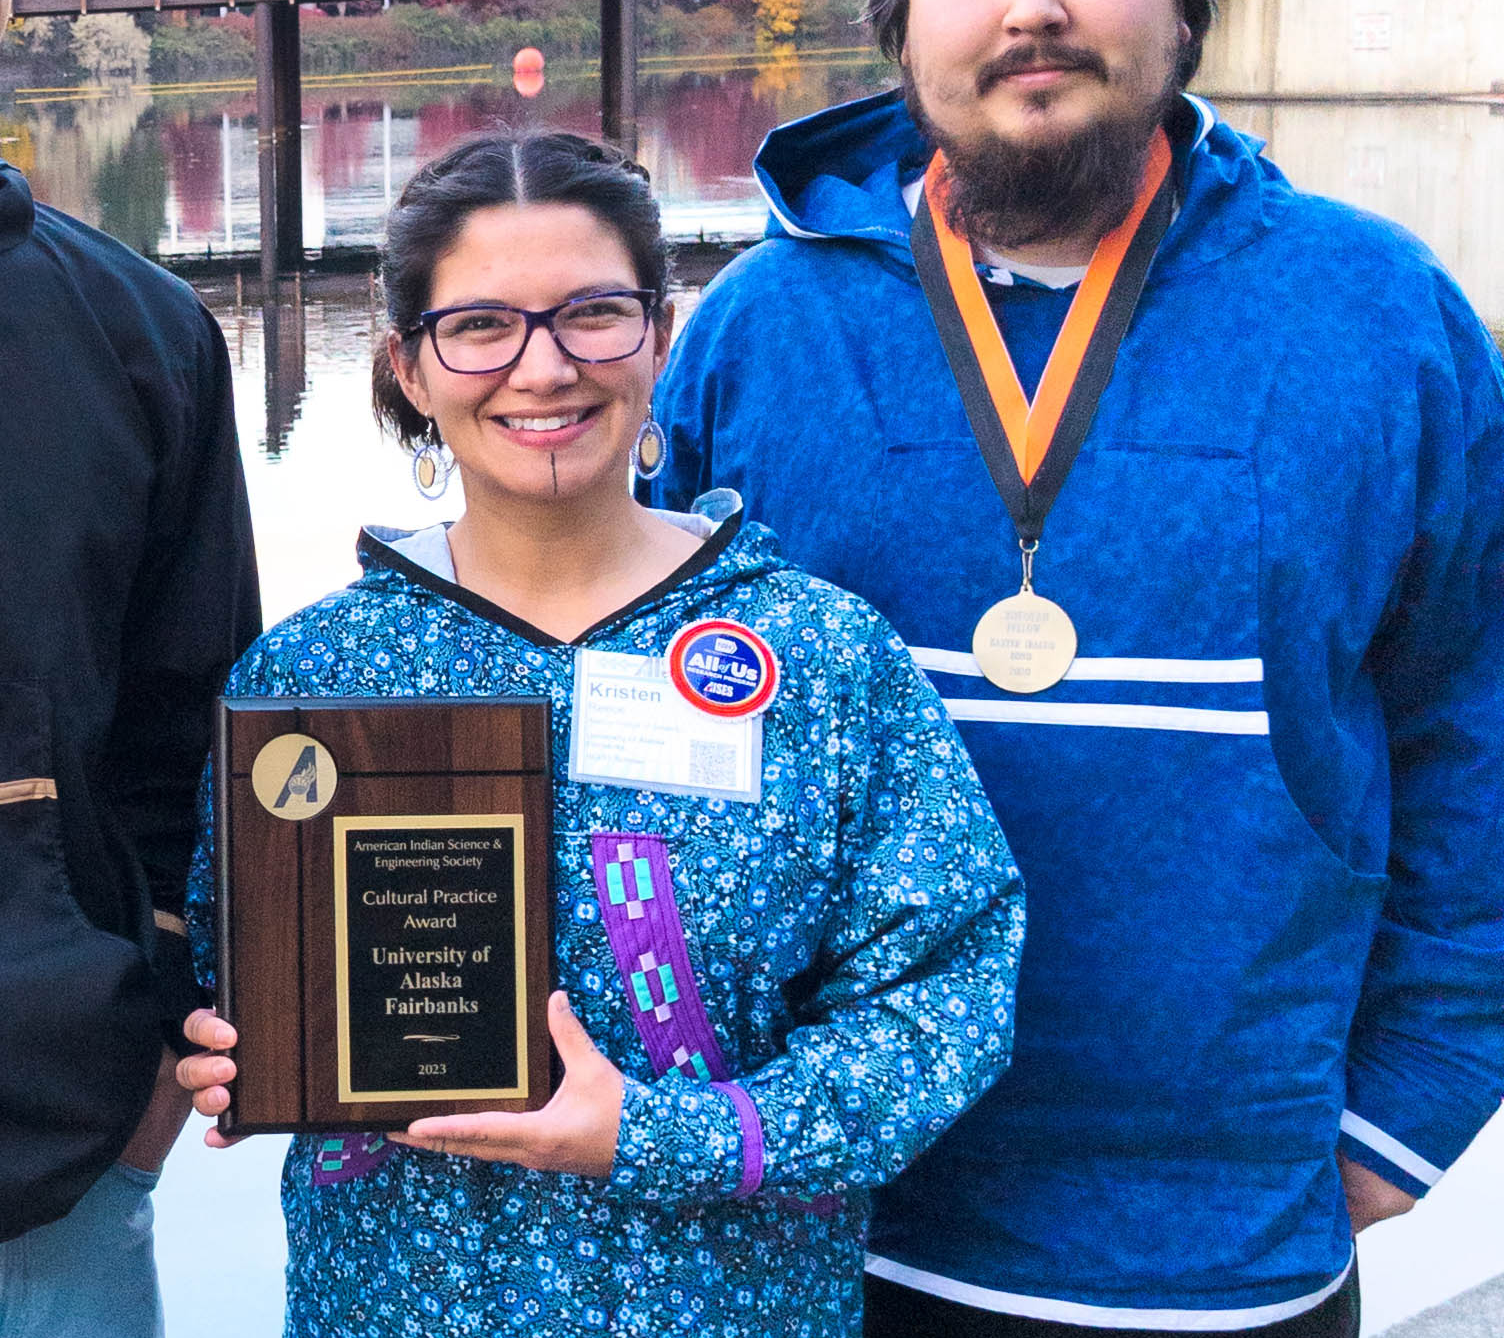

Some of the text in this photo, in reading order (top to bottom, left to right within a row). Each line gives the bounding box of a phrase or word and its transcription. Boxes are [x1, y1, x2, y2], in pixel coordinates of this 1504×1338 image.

[687, 652, 720, 672] All
[718, 663, 732, 674] of
[730, 661, 758, 681] Us
[589, 682, 662, 703] Kristen
[703, 681, 734, 698] AISES
[353, 838, 503, 852] American Indian Science &
[375, 855, 484, 871] Engineering Society
[362, 888, 498, 906] Cultural Practice
[403, 912, 457, 929] Award
[371, 945, 492, 968] University of
[400, 972, 463, 990] Alaska
[384, 996, 479, 1015] Fairbanks
[417, 1063, 447, 1076] 2023
